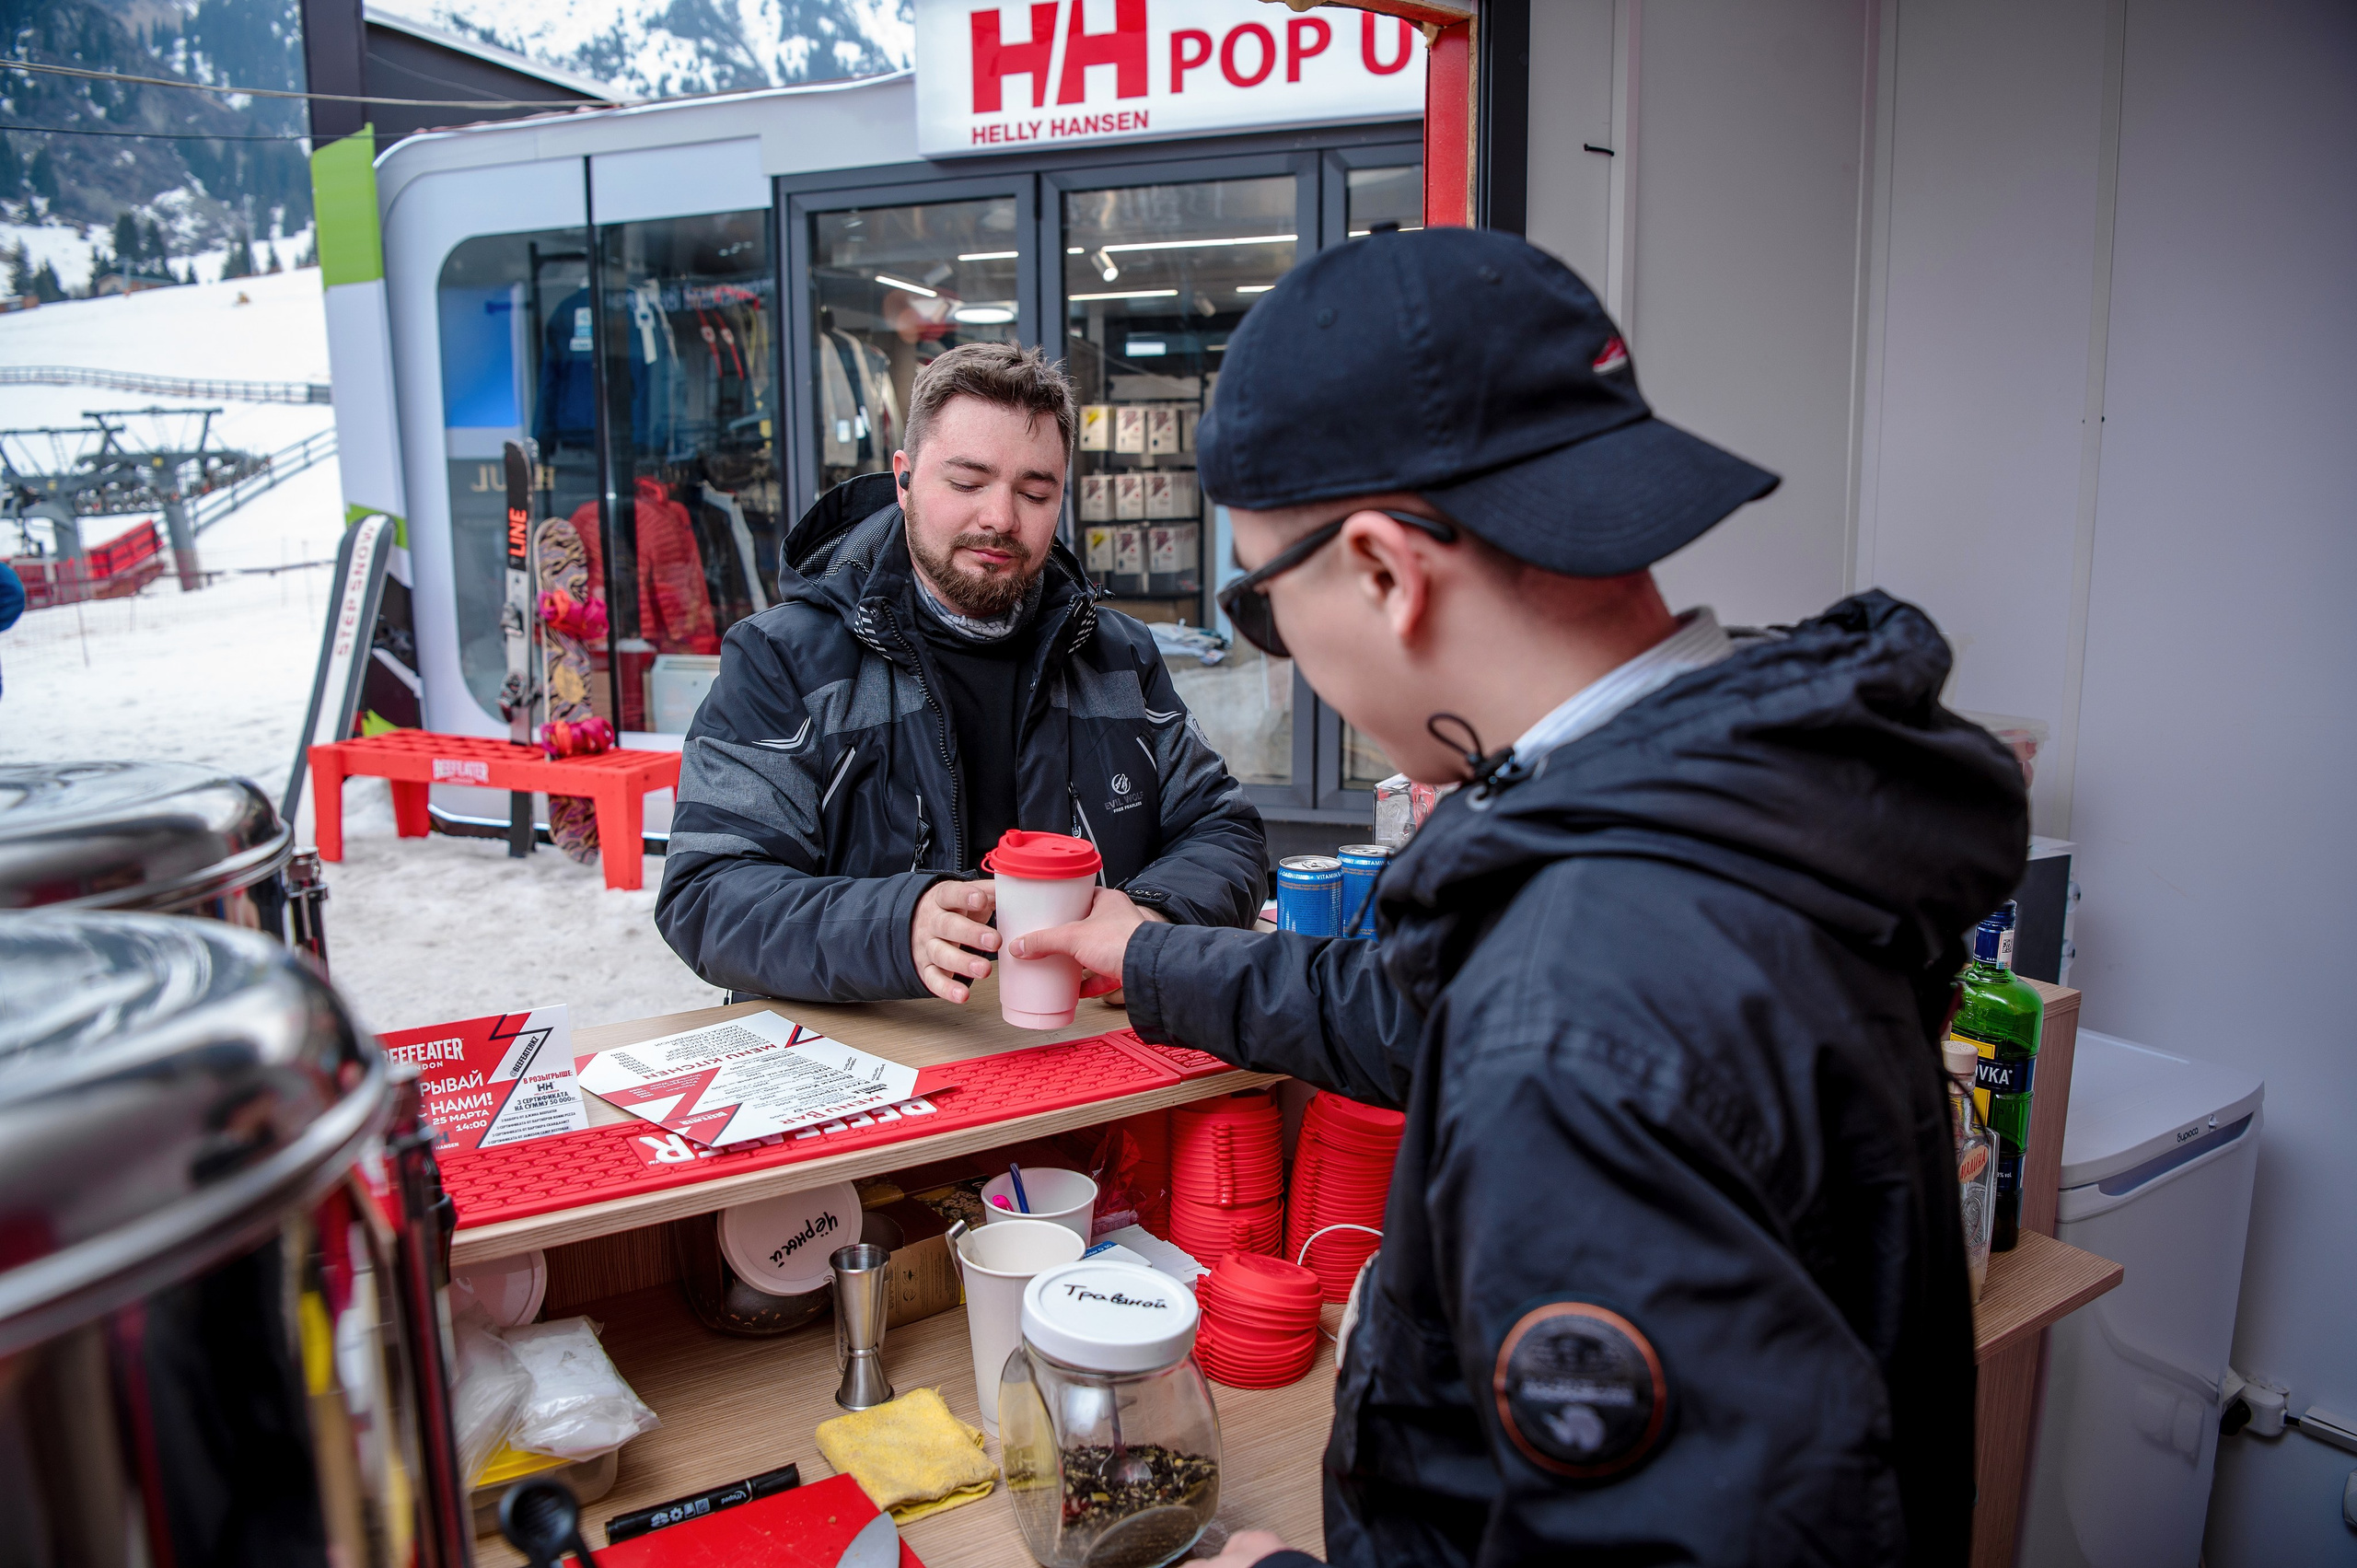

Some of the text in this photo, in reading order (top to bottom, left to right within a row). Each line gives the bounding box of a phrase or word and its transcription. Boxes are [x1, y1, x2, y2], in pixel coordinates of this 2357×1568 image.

[971, 0, 1146, 113] HH
[1170, 17, 1331, 94] POP
[971, 110, 1149, 145] HELLY HANSEN
[509, 507, 528, 557] LINE
[336, 525, 377, 656] STEP SNOW
[432, 758, 489, 783] BEEFEATER
[1105, 791, 1144, 810] EVIL WOLF
[1317, 872, 1337, 880] VITAMIN
[509, 1036, 540, 1078] @BEEFEATERKZ
[726, 1043, 776, 1059] MENU
[415, 1061, 444, 1071] NDON
[528, 1070, 574, 1084] РОЗЫГРЫШЕ:
[641, 1056, 723, 1080] KITCHEN
[420, 1070, 483, 1097] РЫВАЙ
[537, 1082, 554, 1092] HH
[430, 1092, 493, 1115] НАМИ!
[522, 1091, 569, 1104] СЕРТИФИКАТА
[524, 1101, 549, 1109] СУММУ
[432, 1109, 490, 1125] 25 МАРТА
[779, 1095, 883, 1126] MENU BAR
[456, 1120, 487, 1132] 14:00
[2177, 1127, 2199, 1143] бирюса
[769, 1211, 839, 1269] Чёрный
[1064, 1282, 1168, 1312] Травяной
[720, 1490, 747, 1506] Maped
